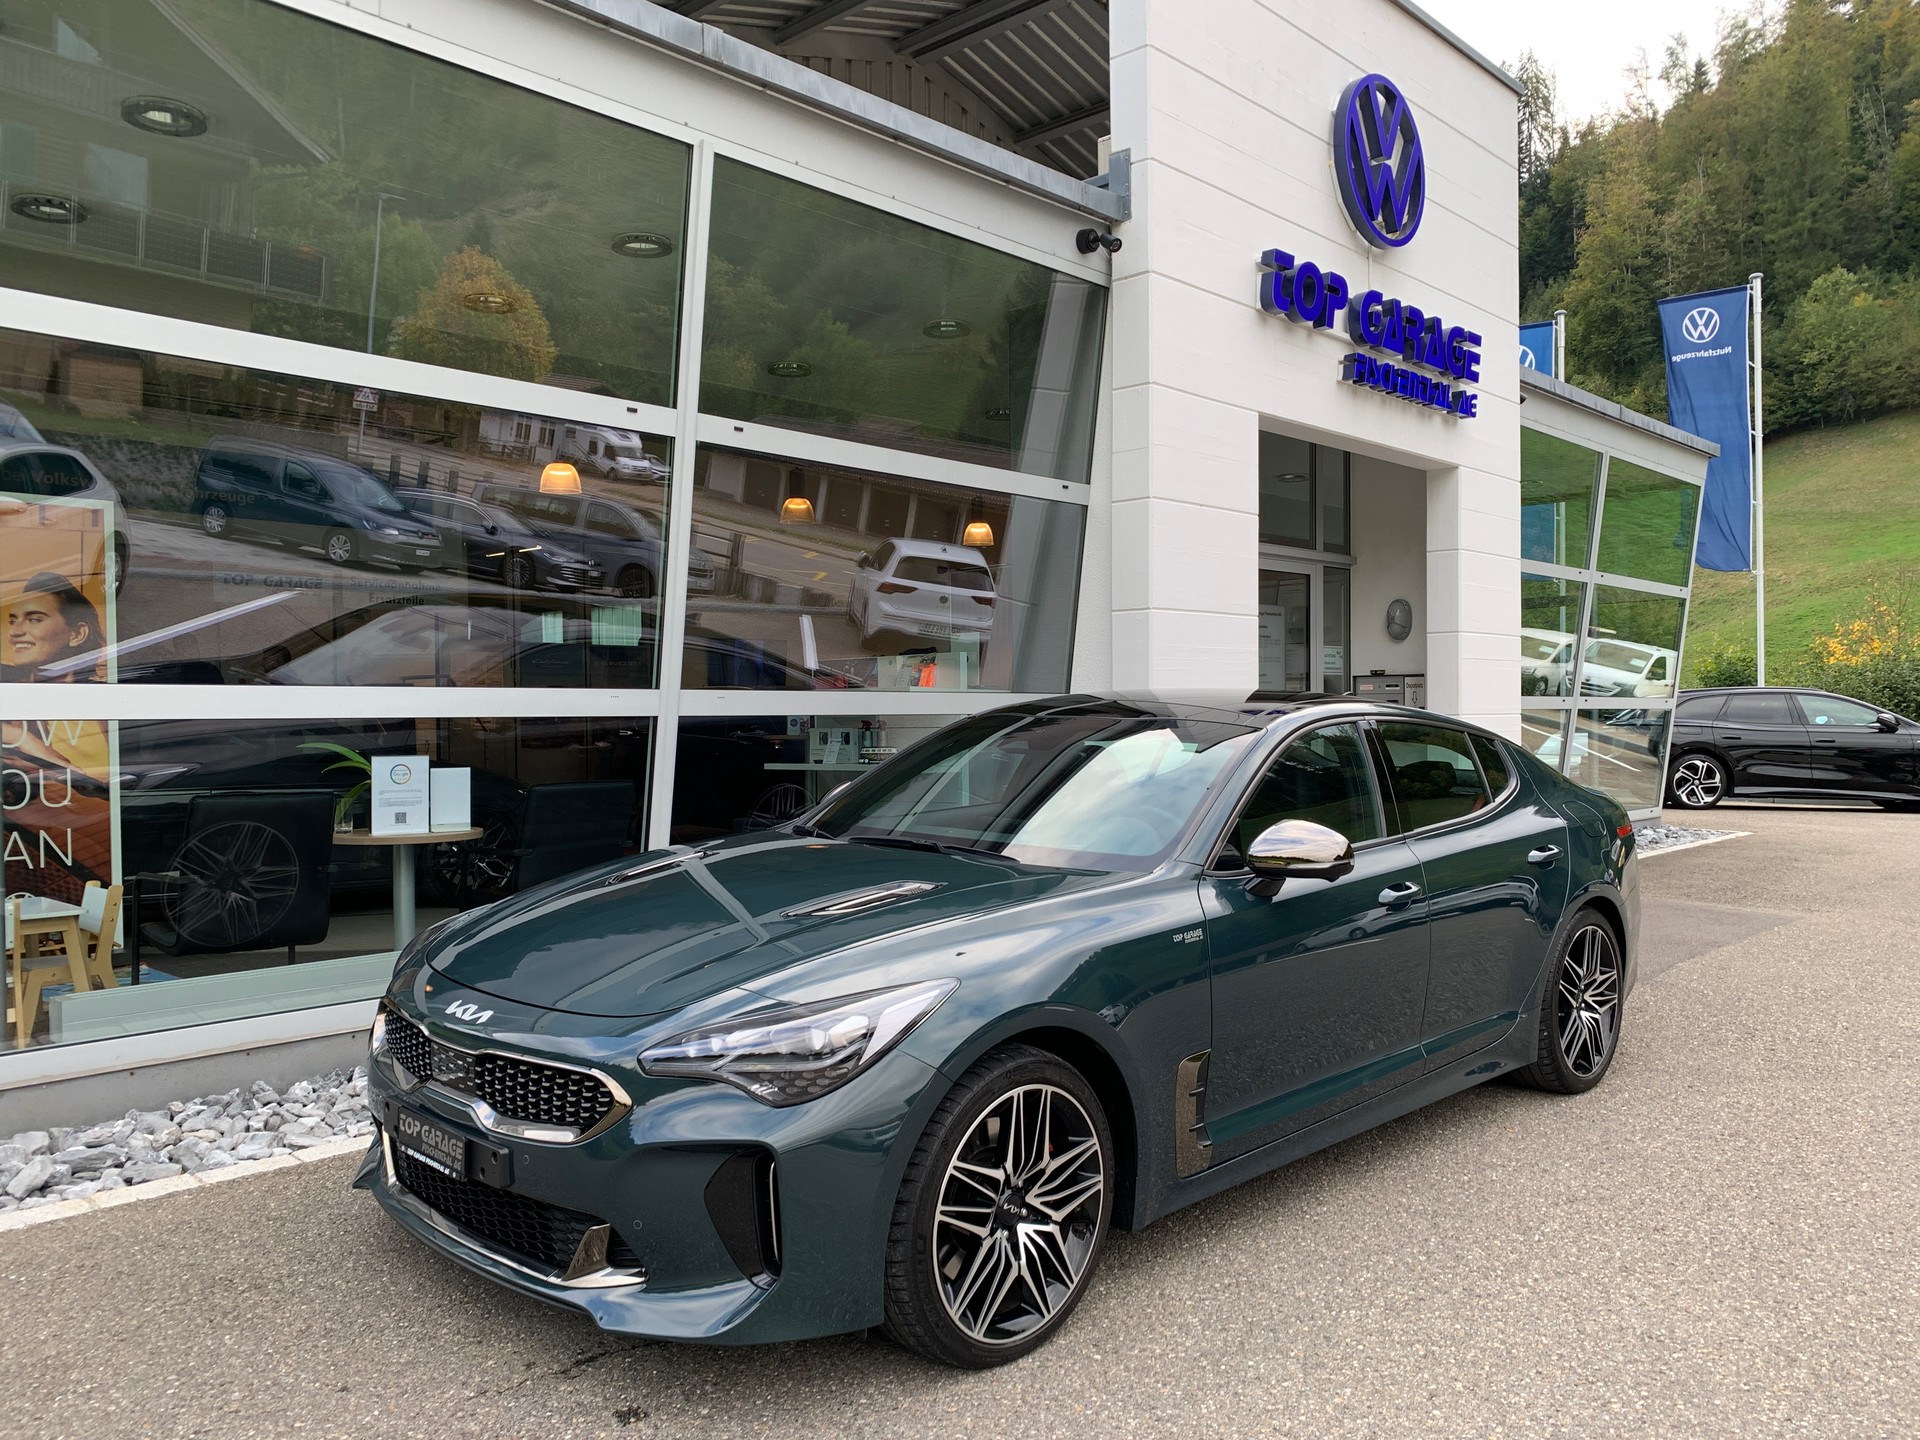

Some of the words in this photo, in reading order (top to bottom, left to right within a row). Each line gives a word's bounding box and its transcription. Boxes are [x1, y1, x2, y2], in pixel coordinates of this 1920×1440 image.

[1262, 248, 1348, 331] TOP
[1349, 289, 1482, 384] GARAGE
[1343, 352, 1453, 412] FISCHENTHAL
[1450, 390, 1478, 419] AG
[369, 592, 425, 605] Ersatzteile
[1173, 933, 1184, 943] TOP
[1184, 928, 1203, 940] GARAGE
[445, 1000, 494, 1024] KIA
[400, 1113, 421, 1137] TOP
[421, 1125, 463, 1159] GARAGE
[453, 1160, 461, 1171] AG
